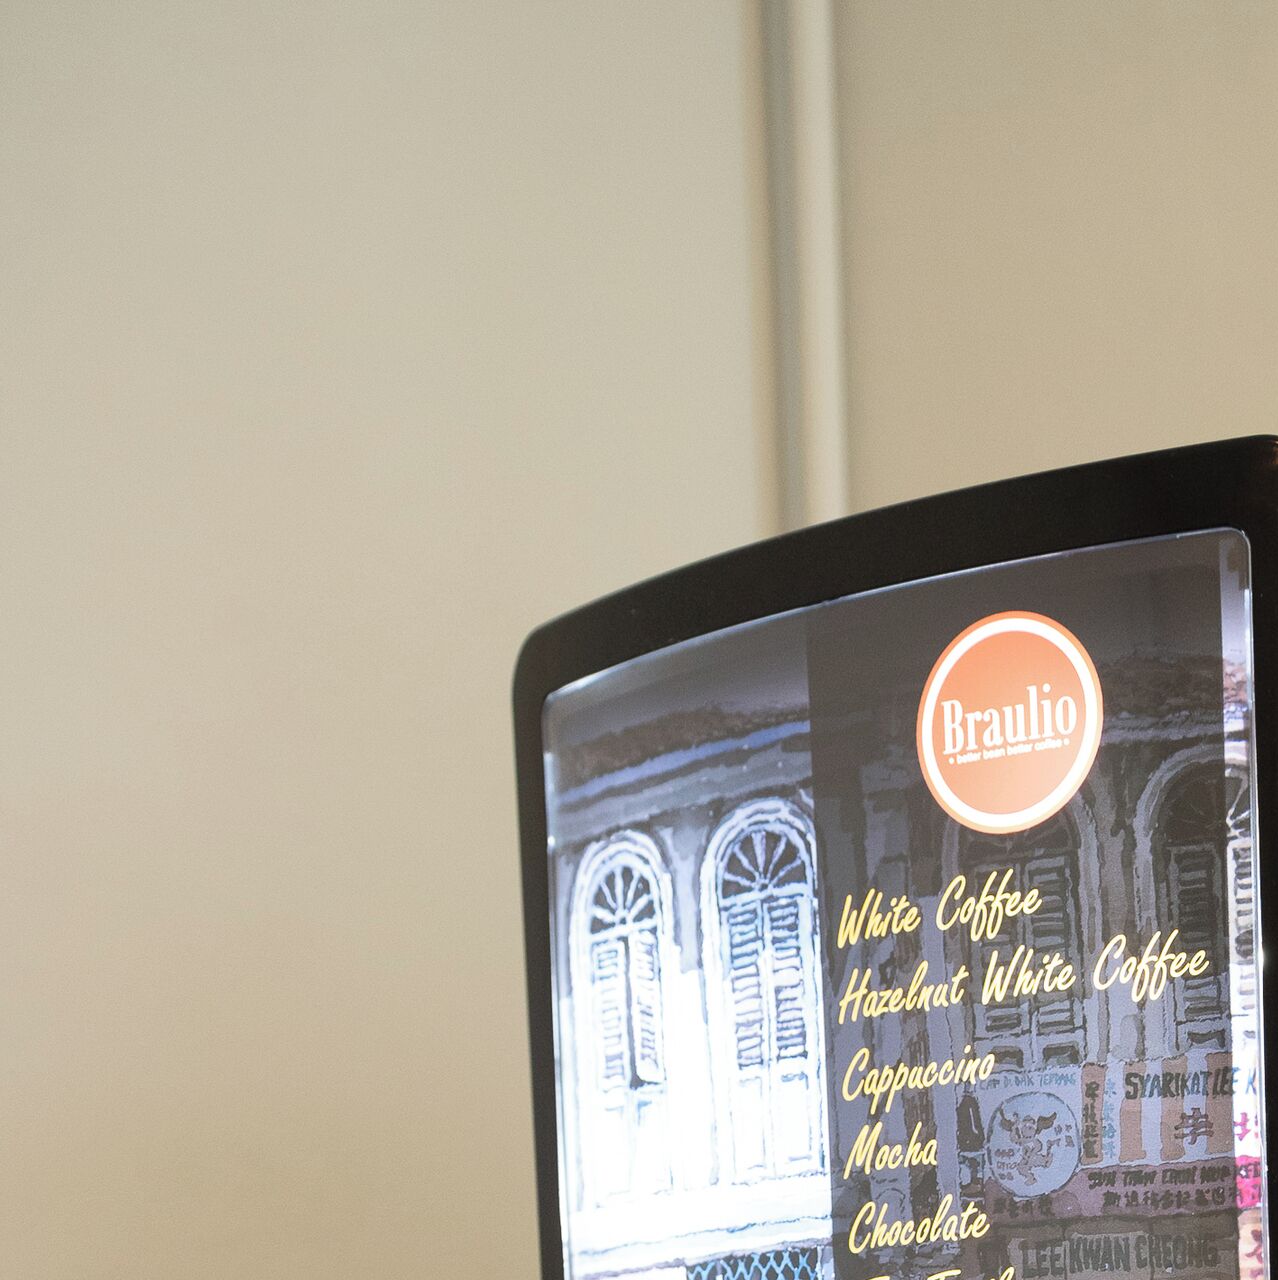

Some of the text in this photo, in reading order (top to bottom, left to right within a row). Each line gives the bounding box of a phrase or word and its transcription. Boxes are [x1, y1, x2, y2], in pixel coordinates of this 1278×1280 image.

[941, 683, 1077, 755] Braulio
[837, 868, 1043, 949] White Coffee
[838, 929, 1210, 1025] Hazelnut White Coffee
[842, 1045, 995, 1115] Cappuccino
[1125, 1069, 1211, 1100] SYARIKAT
[843, 1121, 938, 1180] Mocha
[848, 1194, 990, 1254] Chocolate
[1020, 1238, 1064, 1279] LEE
[1069, 1234, 1131, 1273] KWAN
